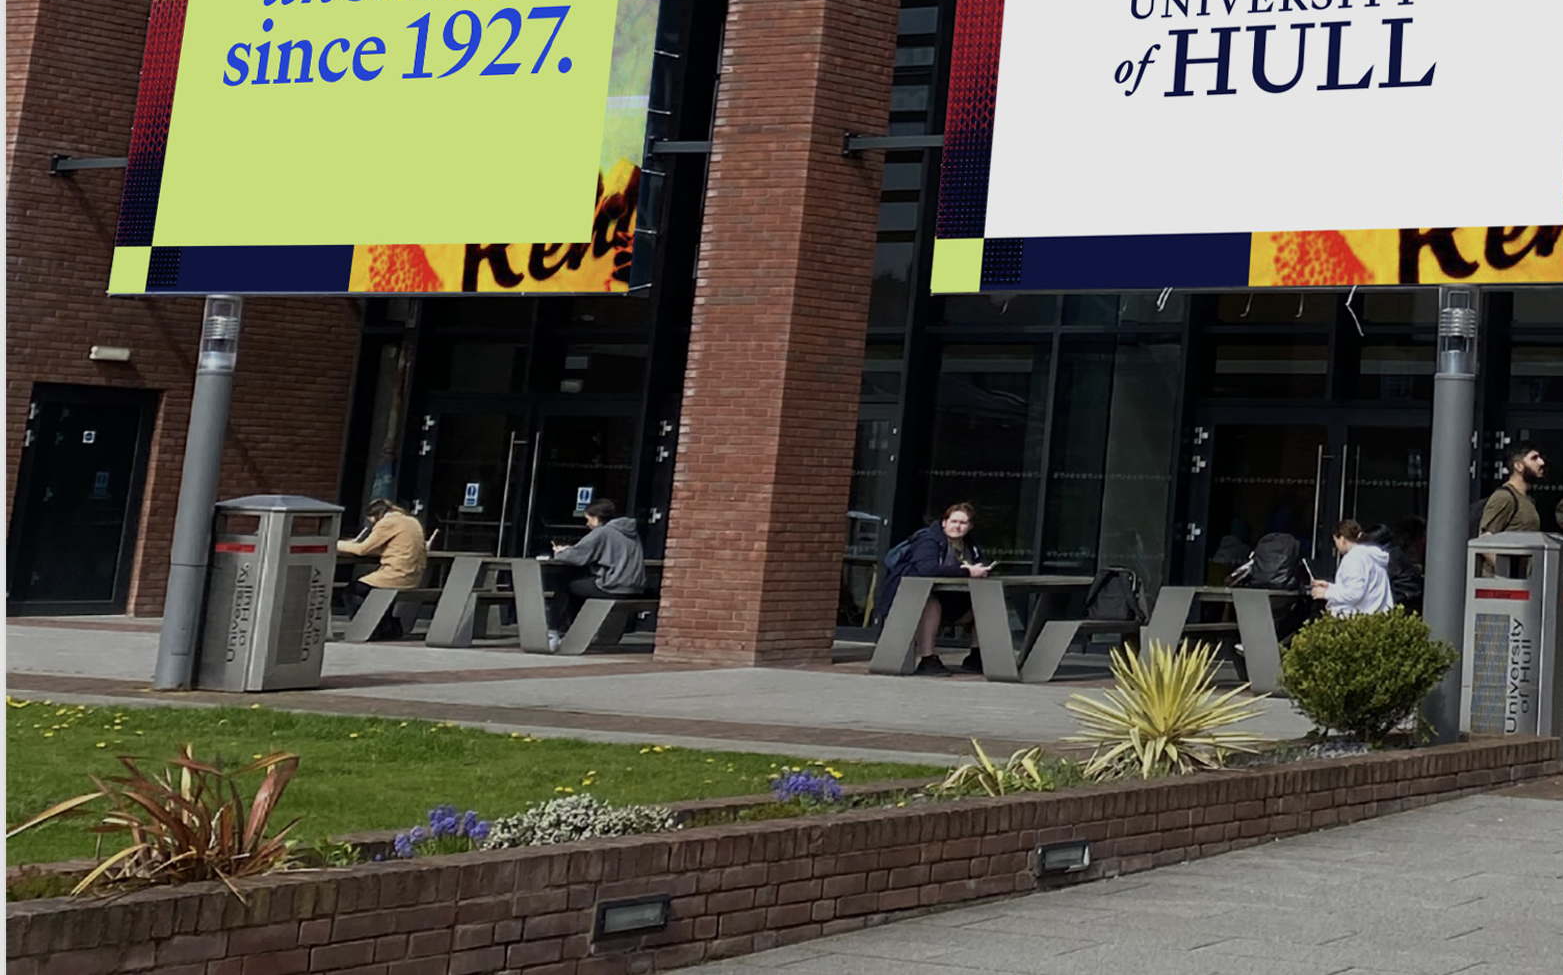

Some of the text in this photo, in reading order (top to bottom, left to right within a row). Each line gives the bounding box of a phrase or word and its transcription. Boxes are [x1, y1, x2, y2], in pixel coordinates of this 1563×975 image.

[222, 5, 573, 87] since 1927.
[1114, 17, 1437, 98] of HULL
[1505, 617, 1525, 734] University
[1519, 639, 1532, 687] Hull
